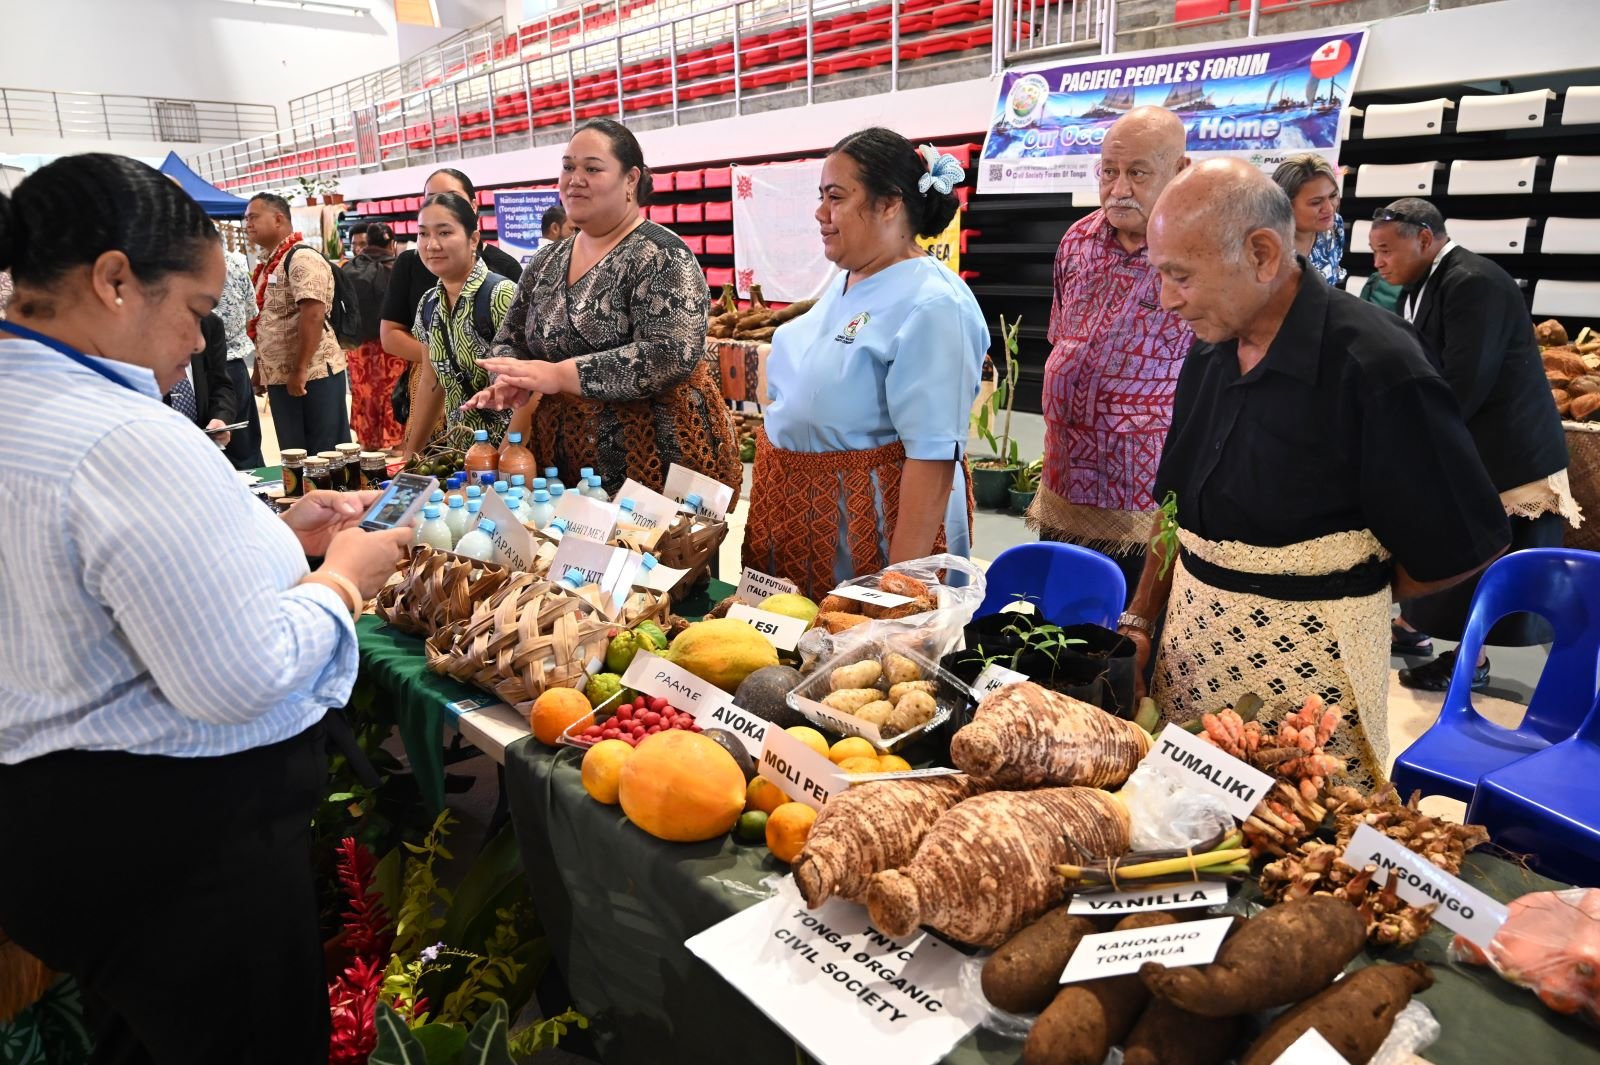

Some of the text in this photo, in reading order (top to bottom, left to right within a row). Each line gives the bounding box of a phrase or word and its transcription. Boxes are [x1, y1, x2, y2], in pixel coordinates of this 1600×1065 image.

[1059, 67, 1121, 92] PACIFIC
[1122, 60, 1200, 88] PEOPLE'S
[1201, 52, 1271, 80] FORUM
[1024, 125, 1110, 149] Our Oce
[1199, 116, 1281, 139] Home
[1070, 169, 1087, 178] Tonga
[927, 244, 950, 261] SEA
[585, 569, 604, 586] KIT
[747, 571, 792, 594] TALO FUTUNA
[746, 584, 768, 597] (TALO
[654, 671, 702, 701] PAAME
[711, 706, 766, 742] AVOKA
[764, 749, 829, 805] MOLI PEI
[1160, 740, 1256, 802] TUMALIKI
[1369, 852, 1475, 919] ANGOANGO
[1088, 890, 1208, 910] VANILLA
[861, 926, 914, 962] TNYC
[1096, 931, 1201, 952] KAHOKAHO
[792, 909, 943, 1013] TONGA ORGANIC
[1096, 945, 1185, 965] TOKAMUA
[774, 928, 907, 1023] CIVIL SOCIETY
